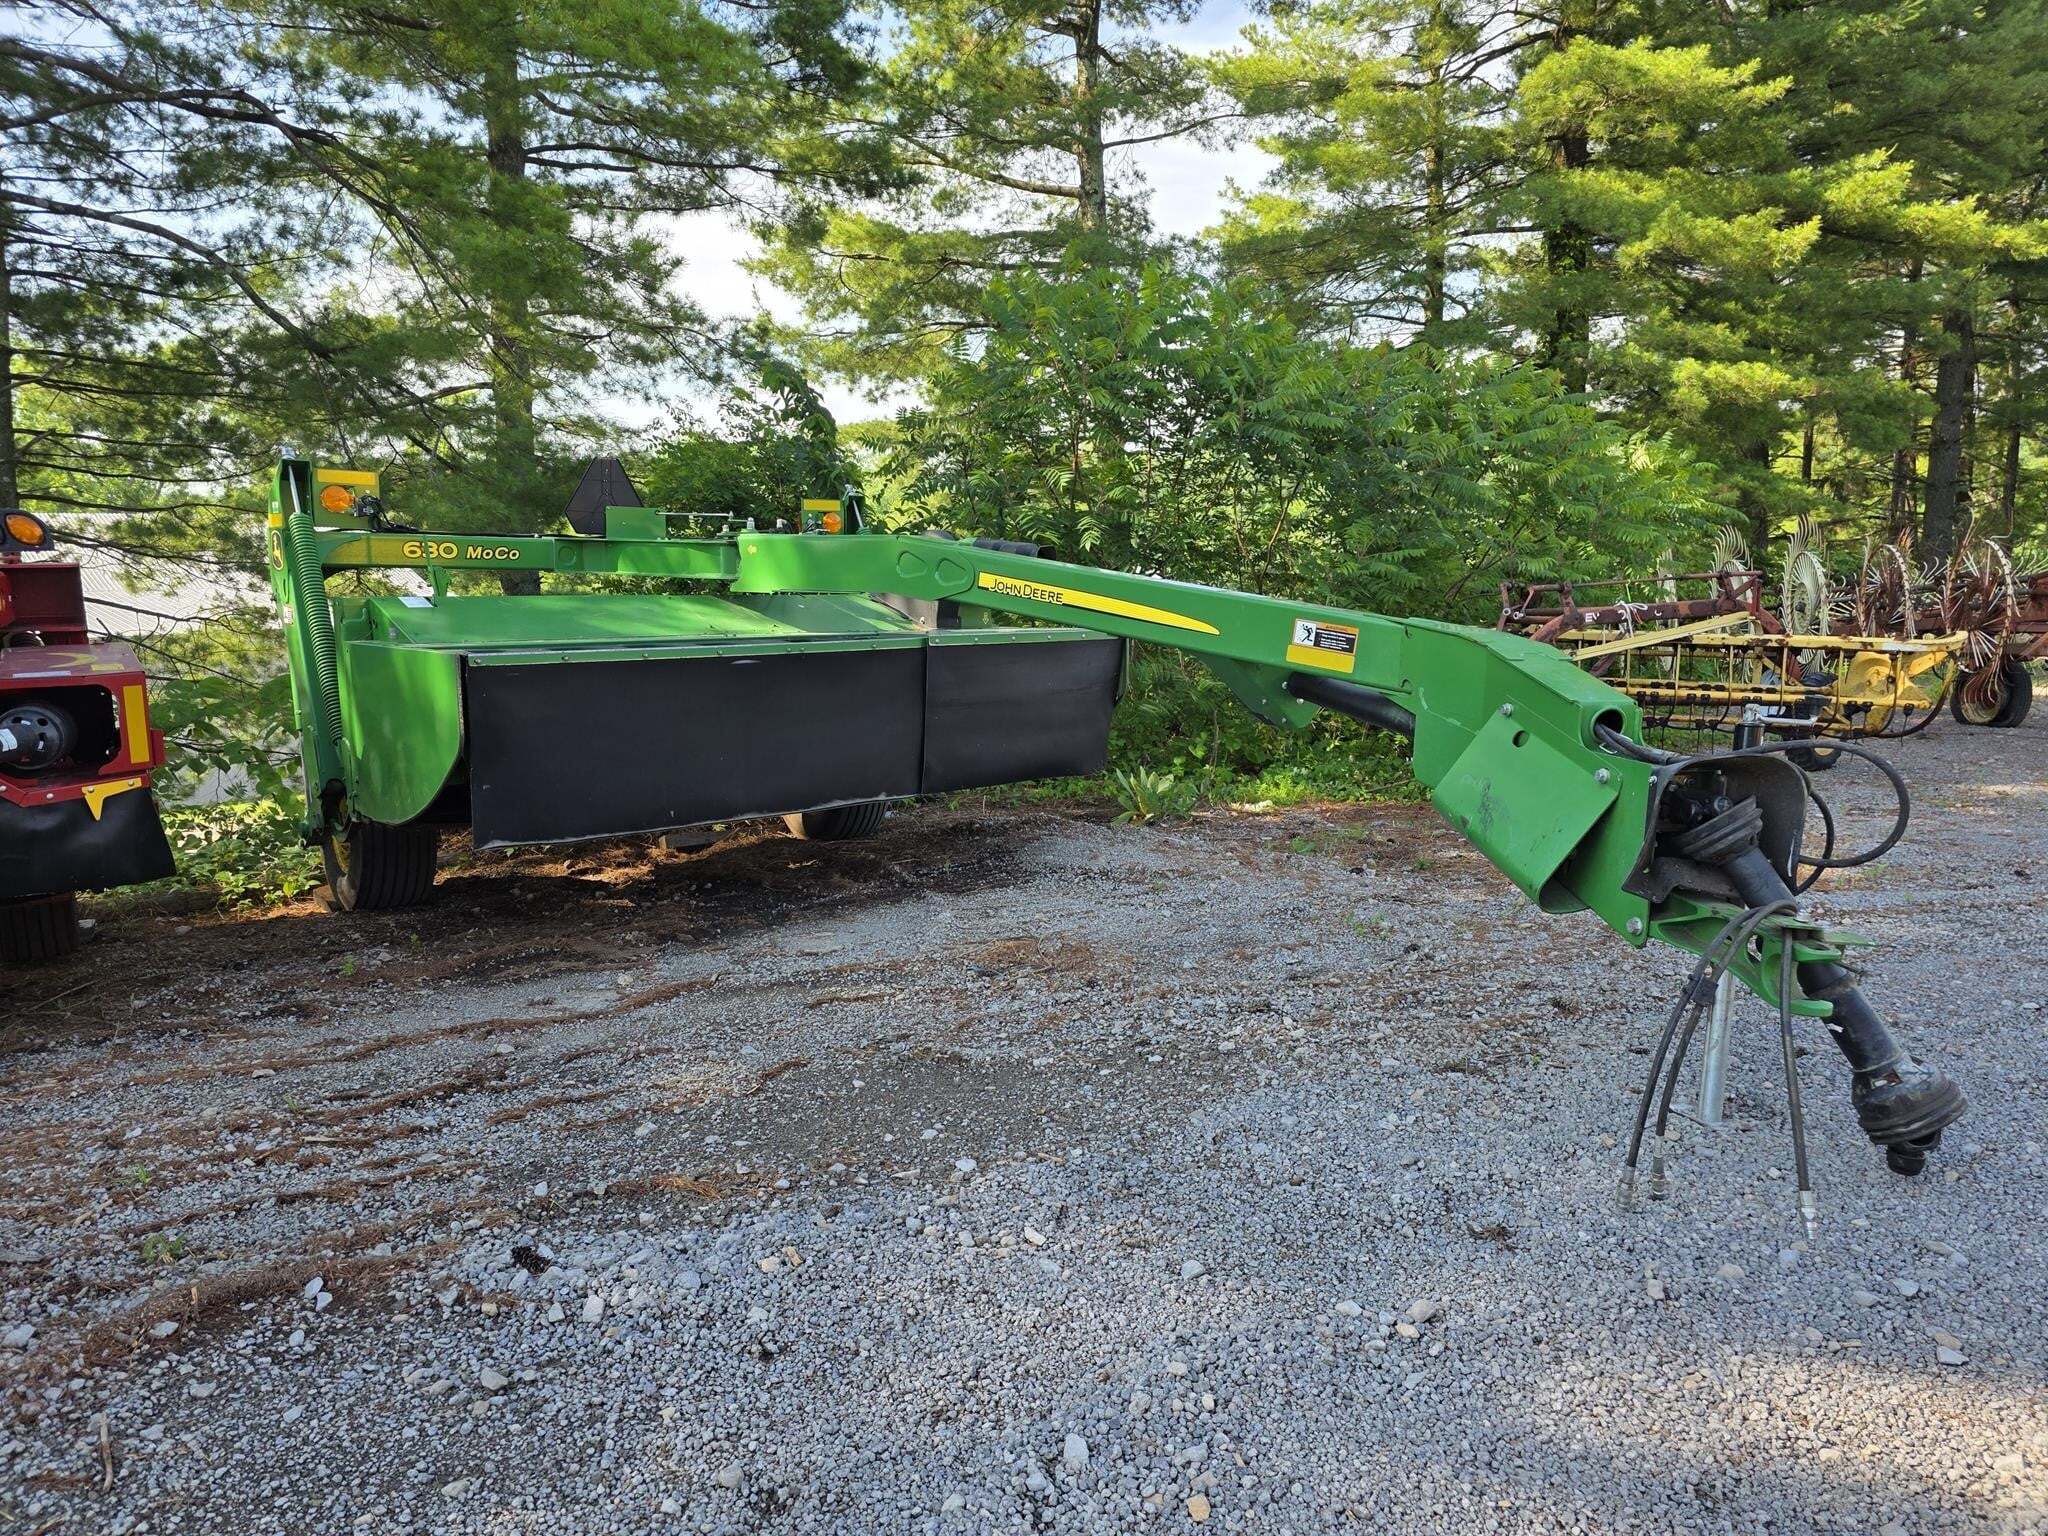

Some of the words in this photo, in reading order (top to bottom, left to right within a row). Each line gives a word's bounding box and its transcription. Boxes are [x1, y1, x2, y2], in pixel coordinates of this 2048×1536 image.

[402, 540, 458, 559] 630
[466, 545, 520, 560] MoCo
[990, 579, 1021, 596] JOHN
[1023, 584, 1063, 603] DEERE
